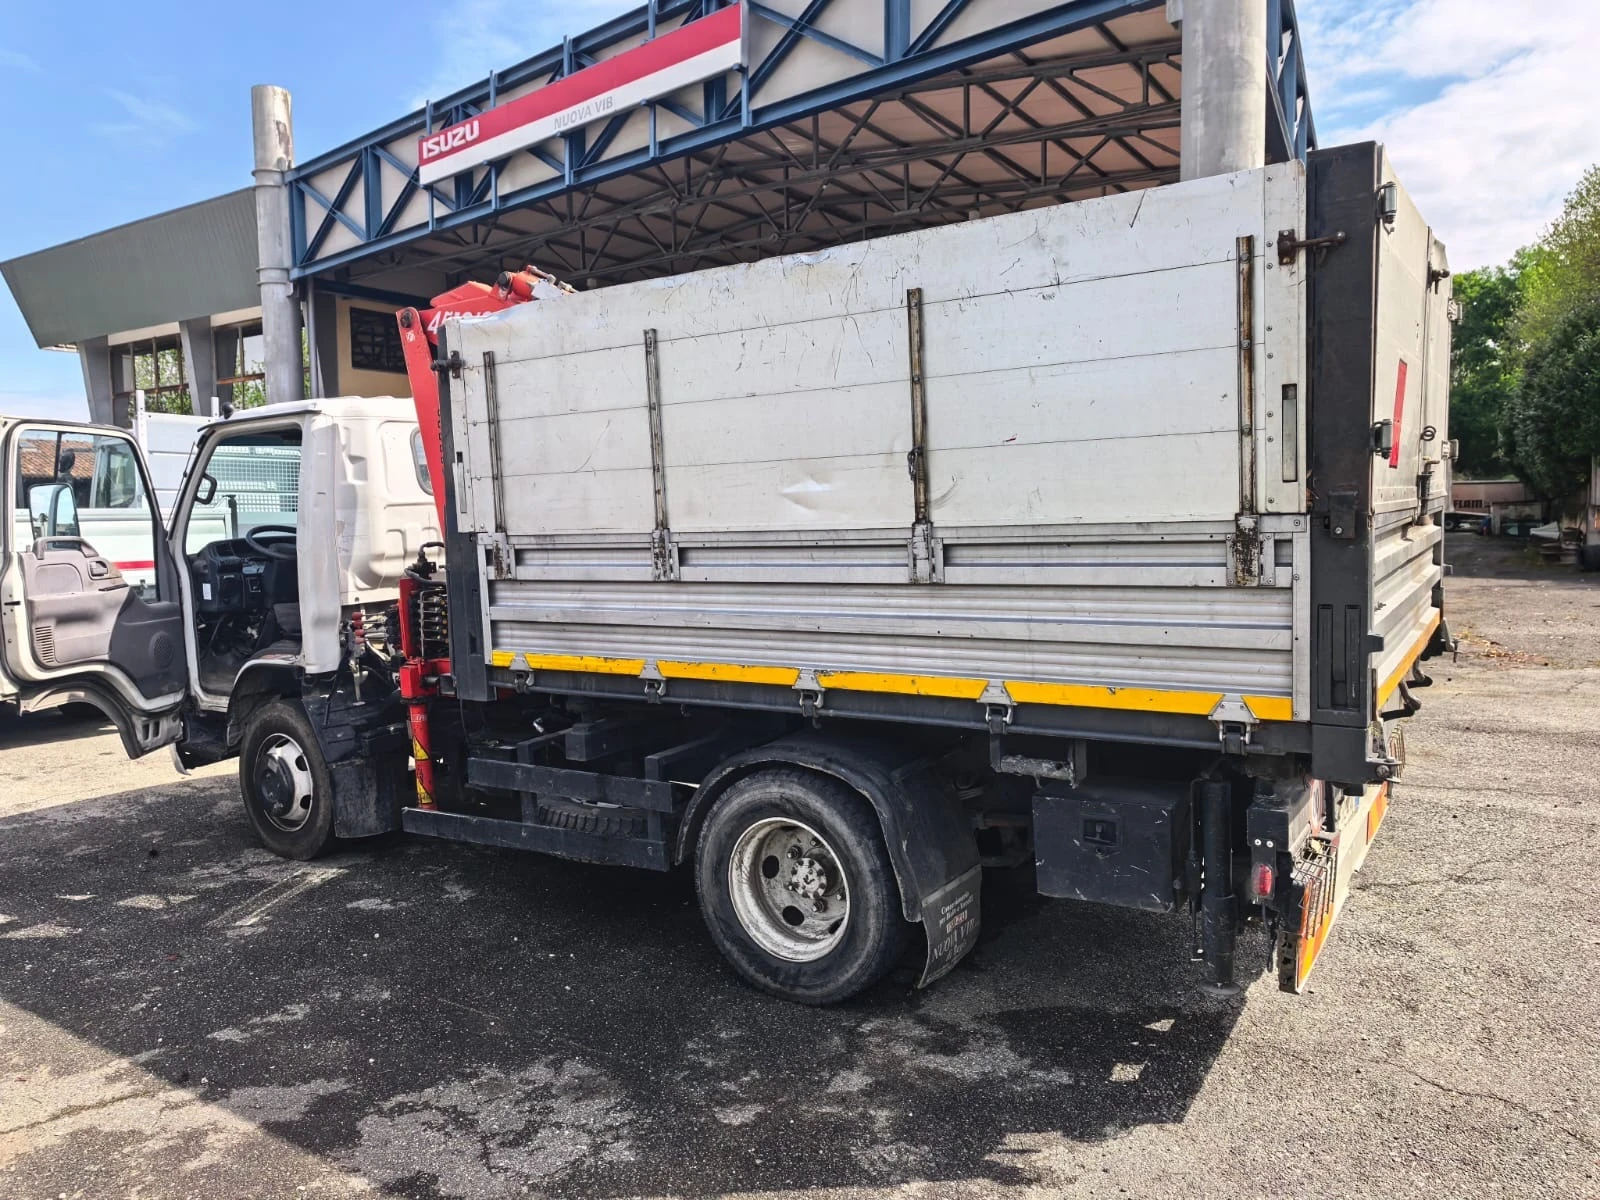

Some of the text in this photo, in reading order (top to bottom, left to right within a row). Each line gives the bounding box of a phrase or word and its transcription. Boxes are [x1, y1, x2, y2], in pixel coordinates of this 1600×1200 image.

[554, 95, 613, 130] NUOVA VIB
[422, 119, 480, 159] ISUZU
